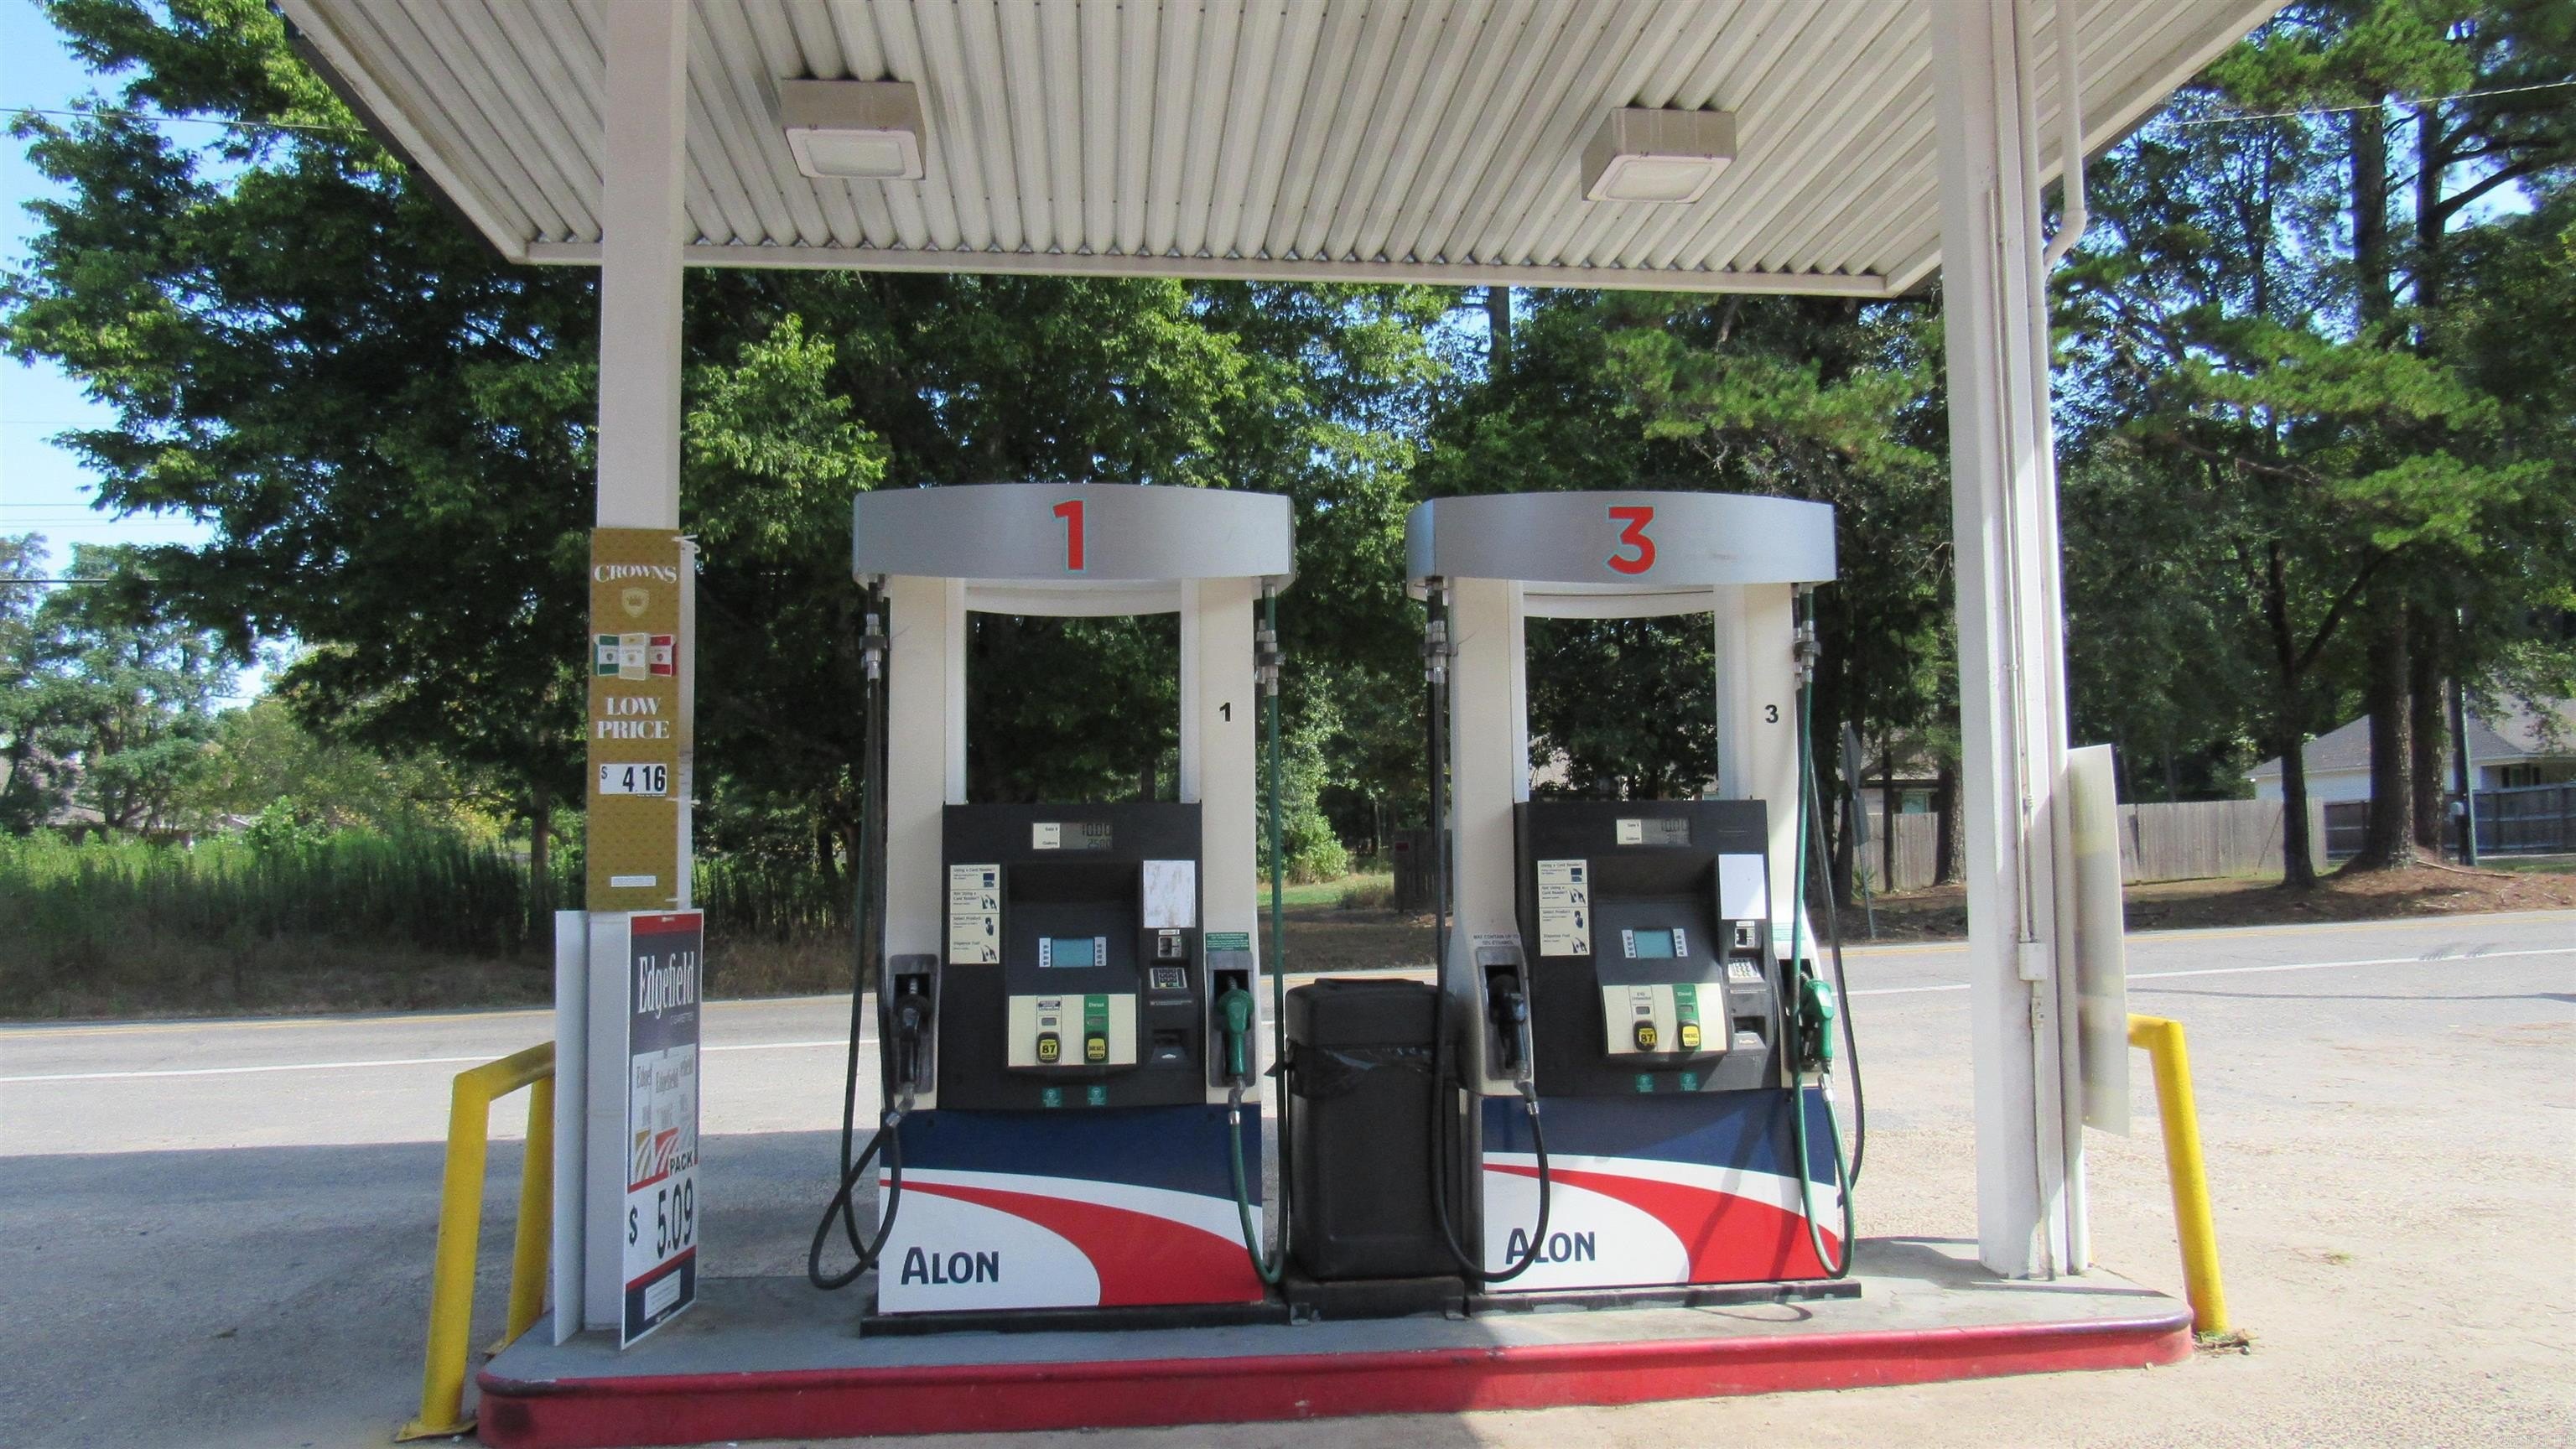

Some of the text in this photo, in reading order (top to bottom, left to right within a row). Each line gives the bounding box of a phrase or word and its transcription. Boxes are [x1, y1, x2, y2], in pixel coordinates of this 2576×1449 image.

[1052, 499, 1085, 571] 1
[1607, 506, 1656, 575] 3
[594, 564, 678, 584] CROWNS
[605, 697, 661, 715] LOW
[1219, 702, 1231, 722] 1
[1764, 704, 1779, 724] 3
[597, 720, 670, 739] PRICE
[600, 766, 608, 780] $
[638, 951, 695, 1020] Edgefield
[1640, 1033, 1654, 1042] 87
[1041, 1045, 1056, 1054] 87
[670, 1150, 694, 1176] PACK
[629, 1177, 693, 1259] $ 5.09
[901, 1246, 999, 1285] ALON
